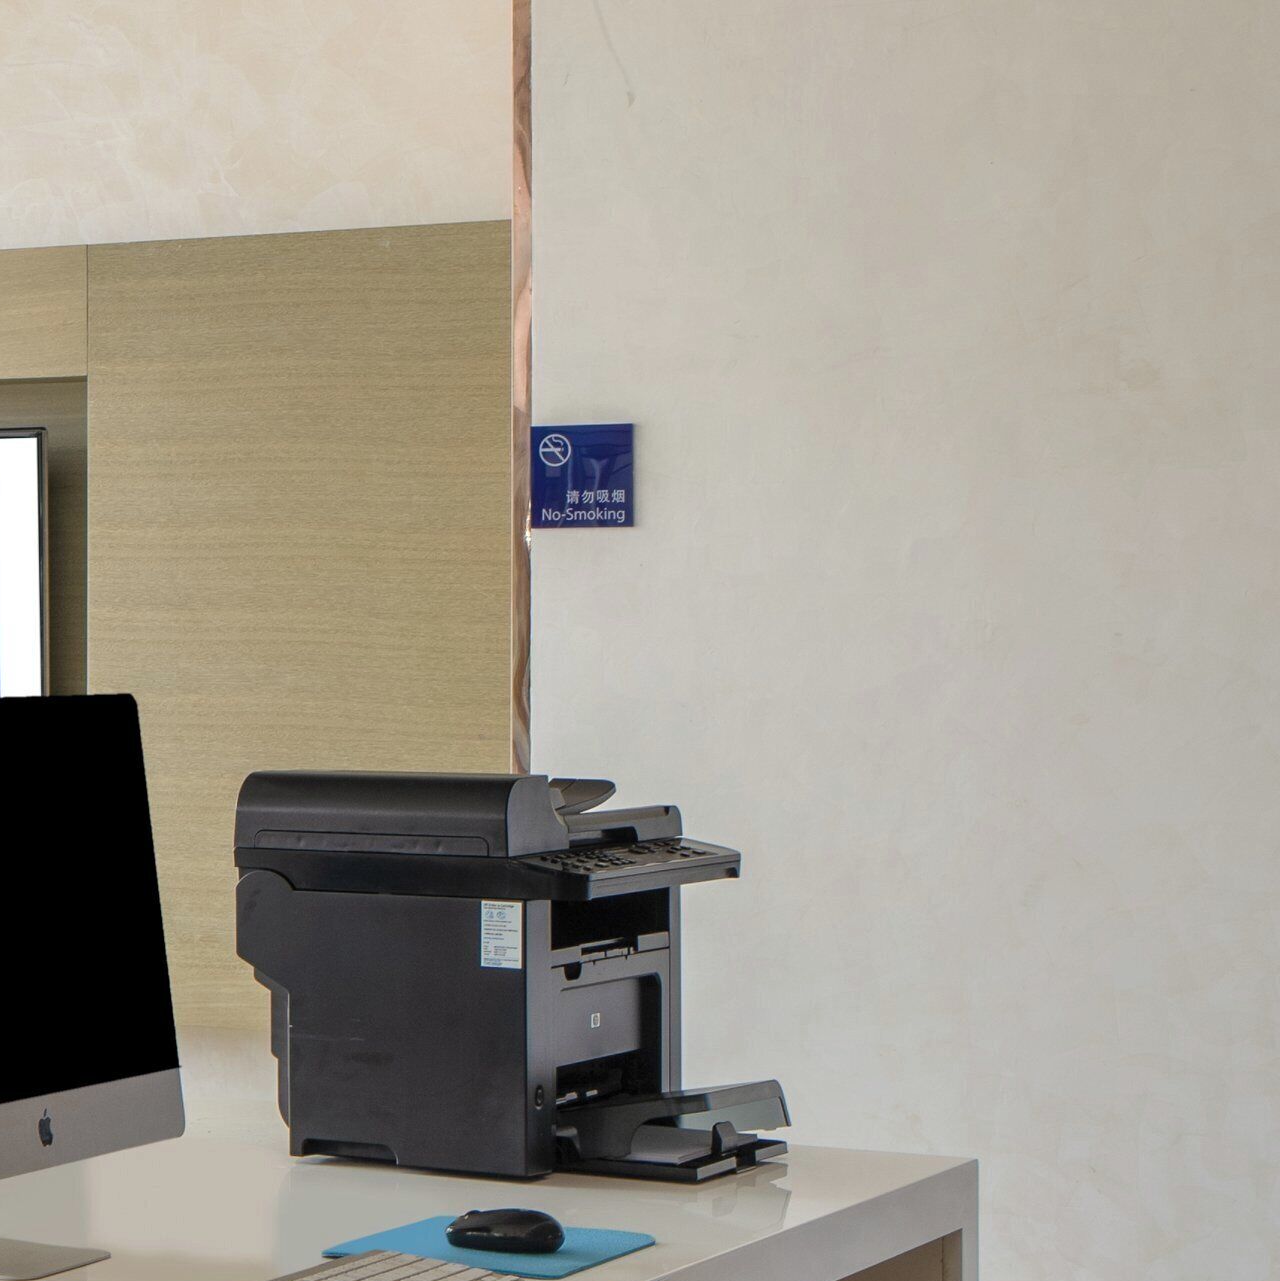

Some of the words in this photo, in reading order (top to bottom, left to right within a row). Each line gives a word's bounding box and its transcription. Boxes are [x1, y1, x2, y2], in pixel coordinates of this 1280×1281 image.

[566, 489, 626, 504] 请勿吸烟
[541, 507, 626, 523] No-Smoking
